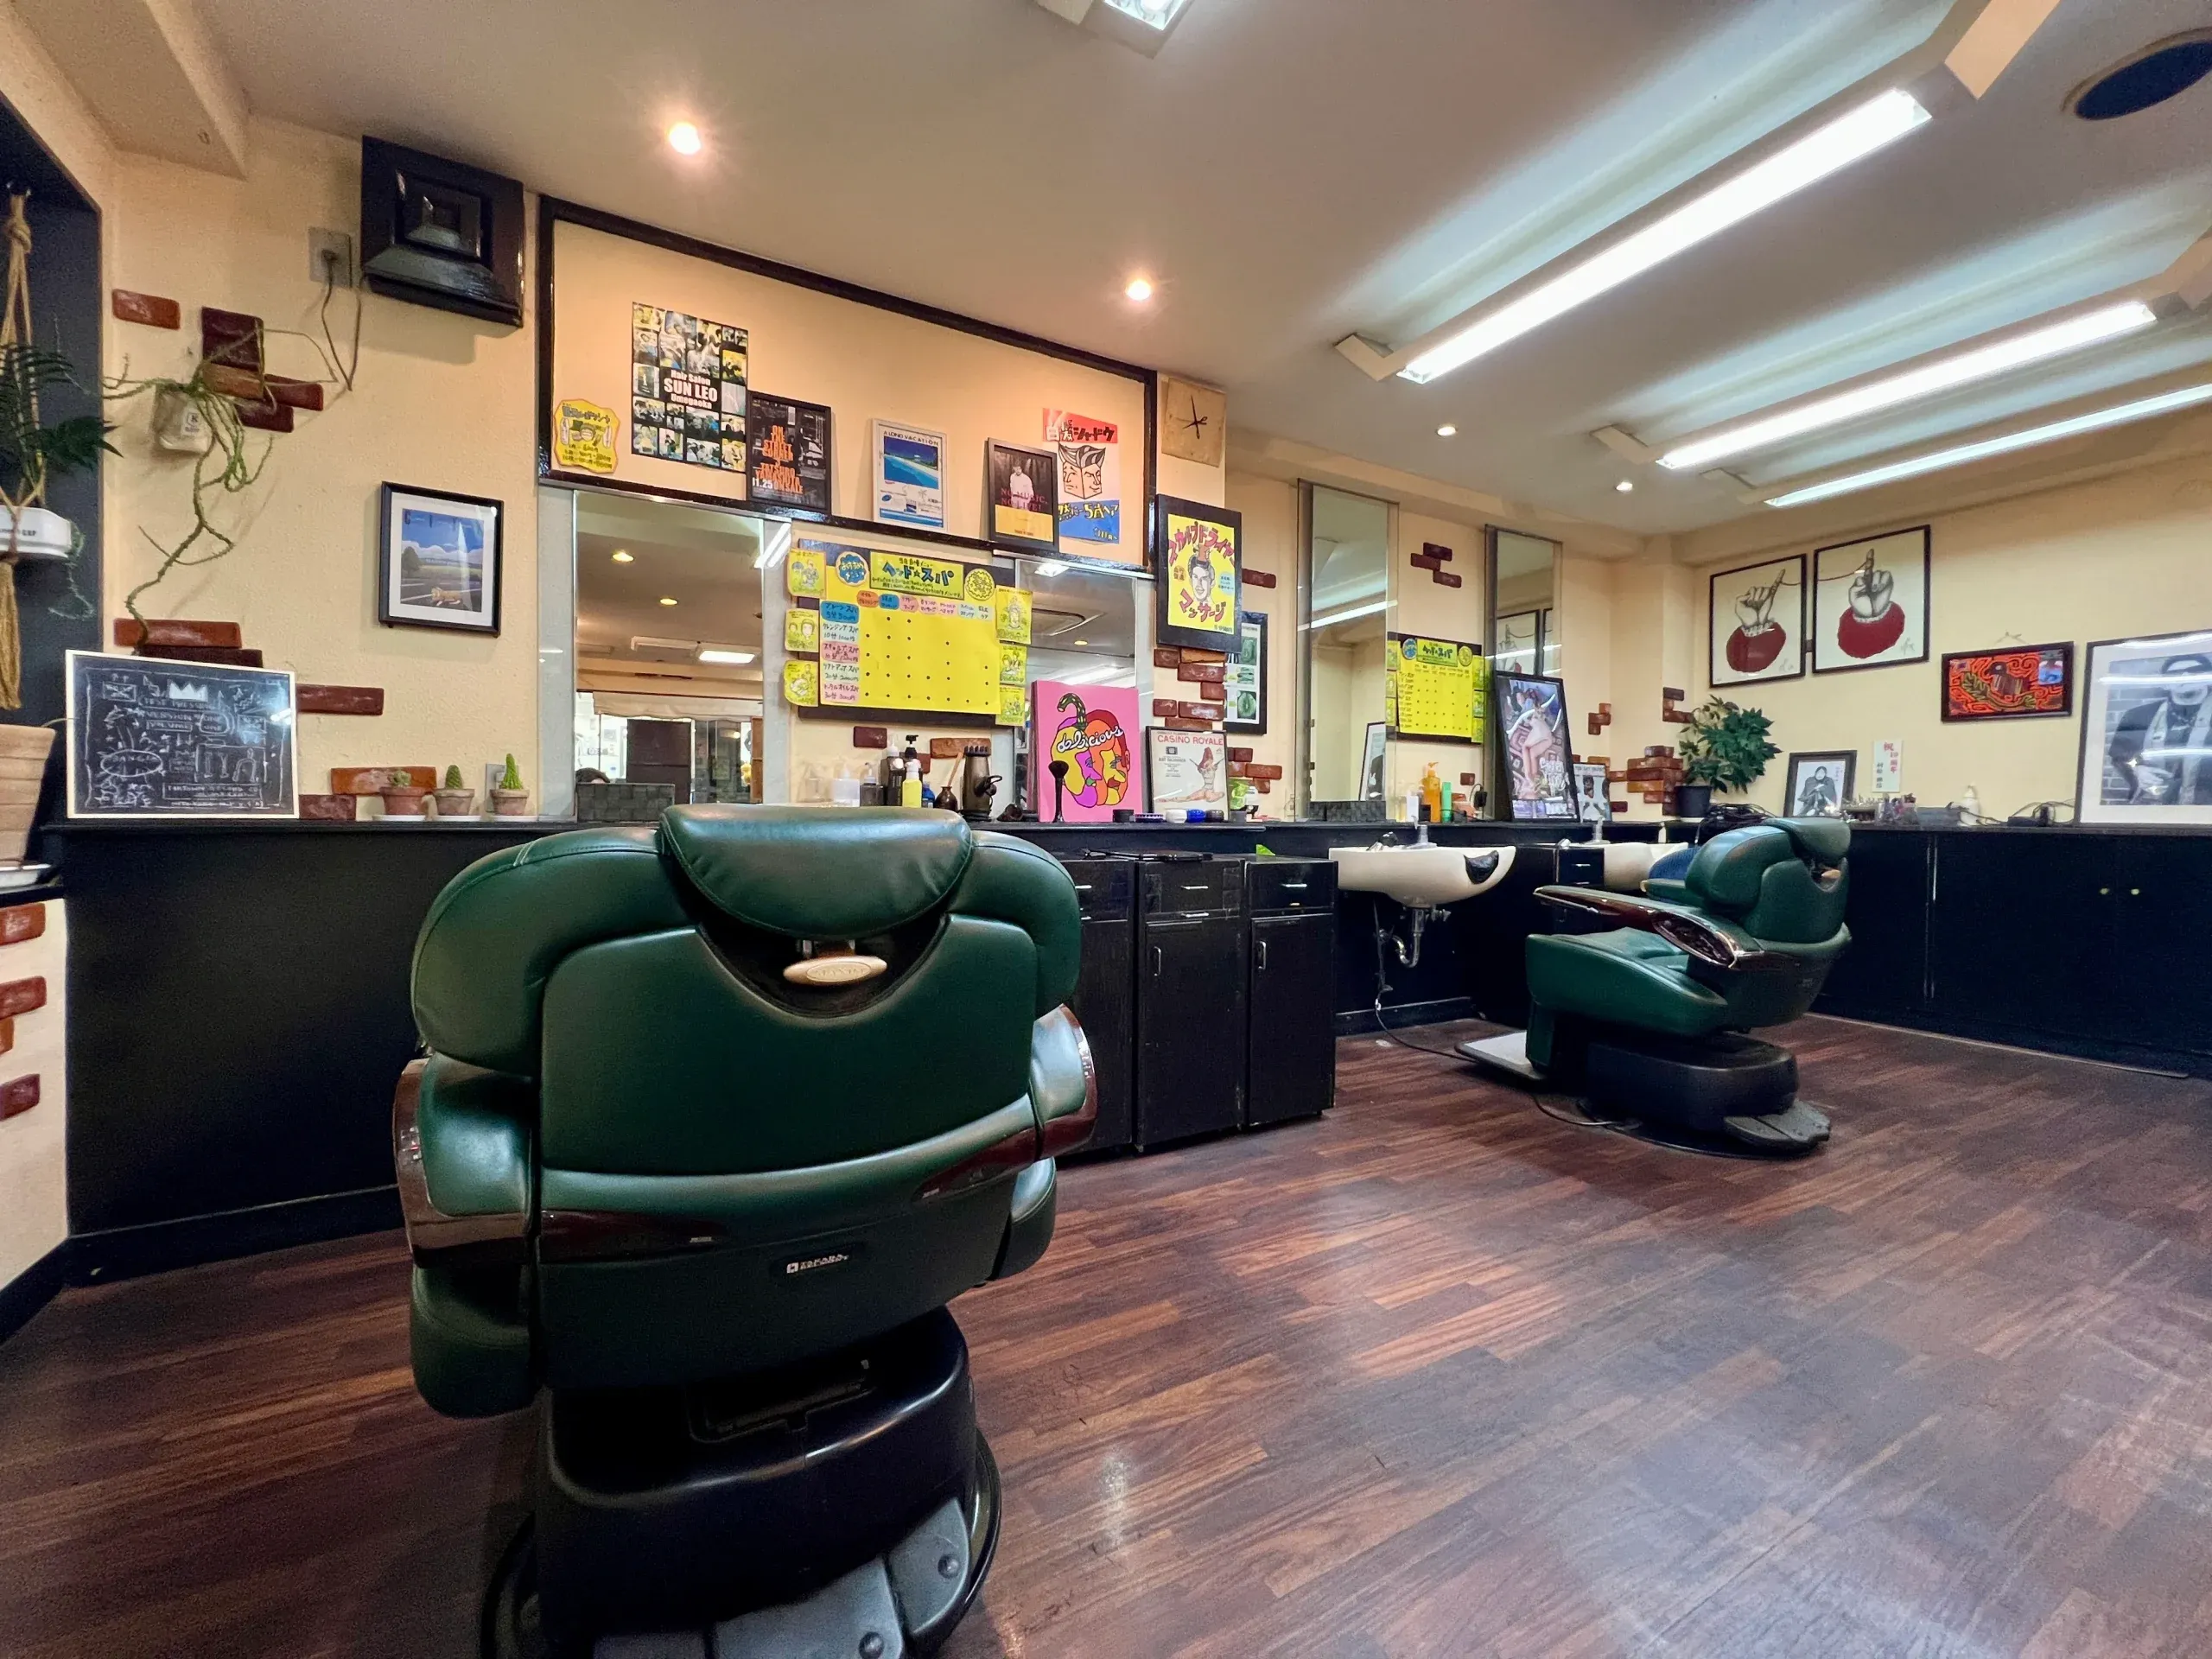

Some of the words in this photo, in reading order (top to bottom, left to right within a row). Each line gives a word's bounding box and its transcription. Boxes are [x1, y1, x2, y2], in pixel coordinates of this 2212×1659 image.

[671, 369, 688, 380] Hair
[688, 373, 711, 386] Salon
[664, 378, 692, 397] SUN
[694, 384, 718, 403] LEO
[904, 435, 939, 447] VACATION
[752, 477, 773, 489] 11.25
[1179, 588, 1226, 622] マッサージ
[1056, 724, 1124, 753] delicious
[1157, 734, 1191, 744] CASINO
[1192, 736, 1224, 746] ROYALE
